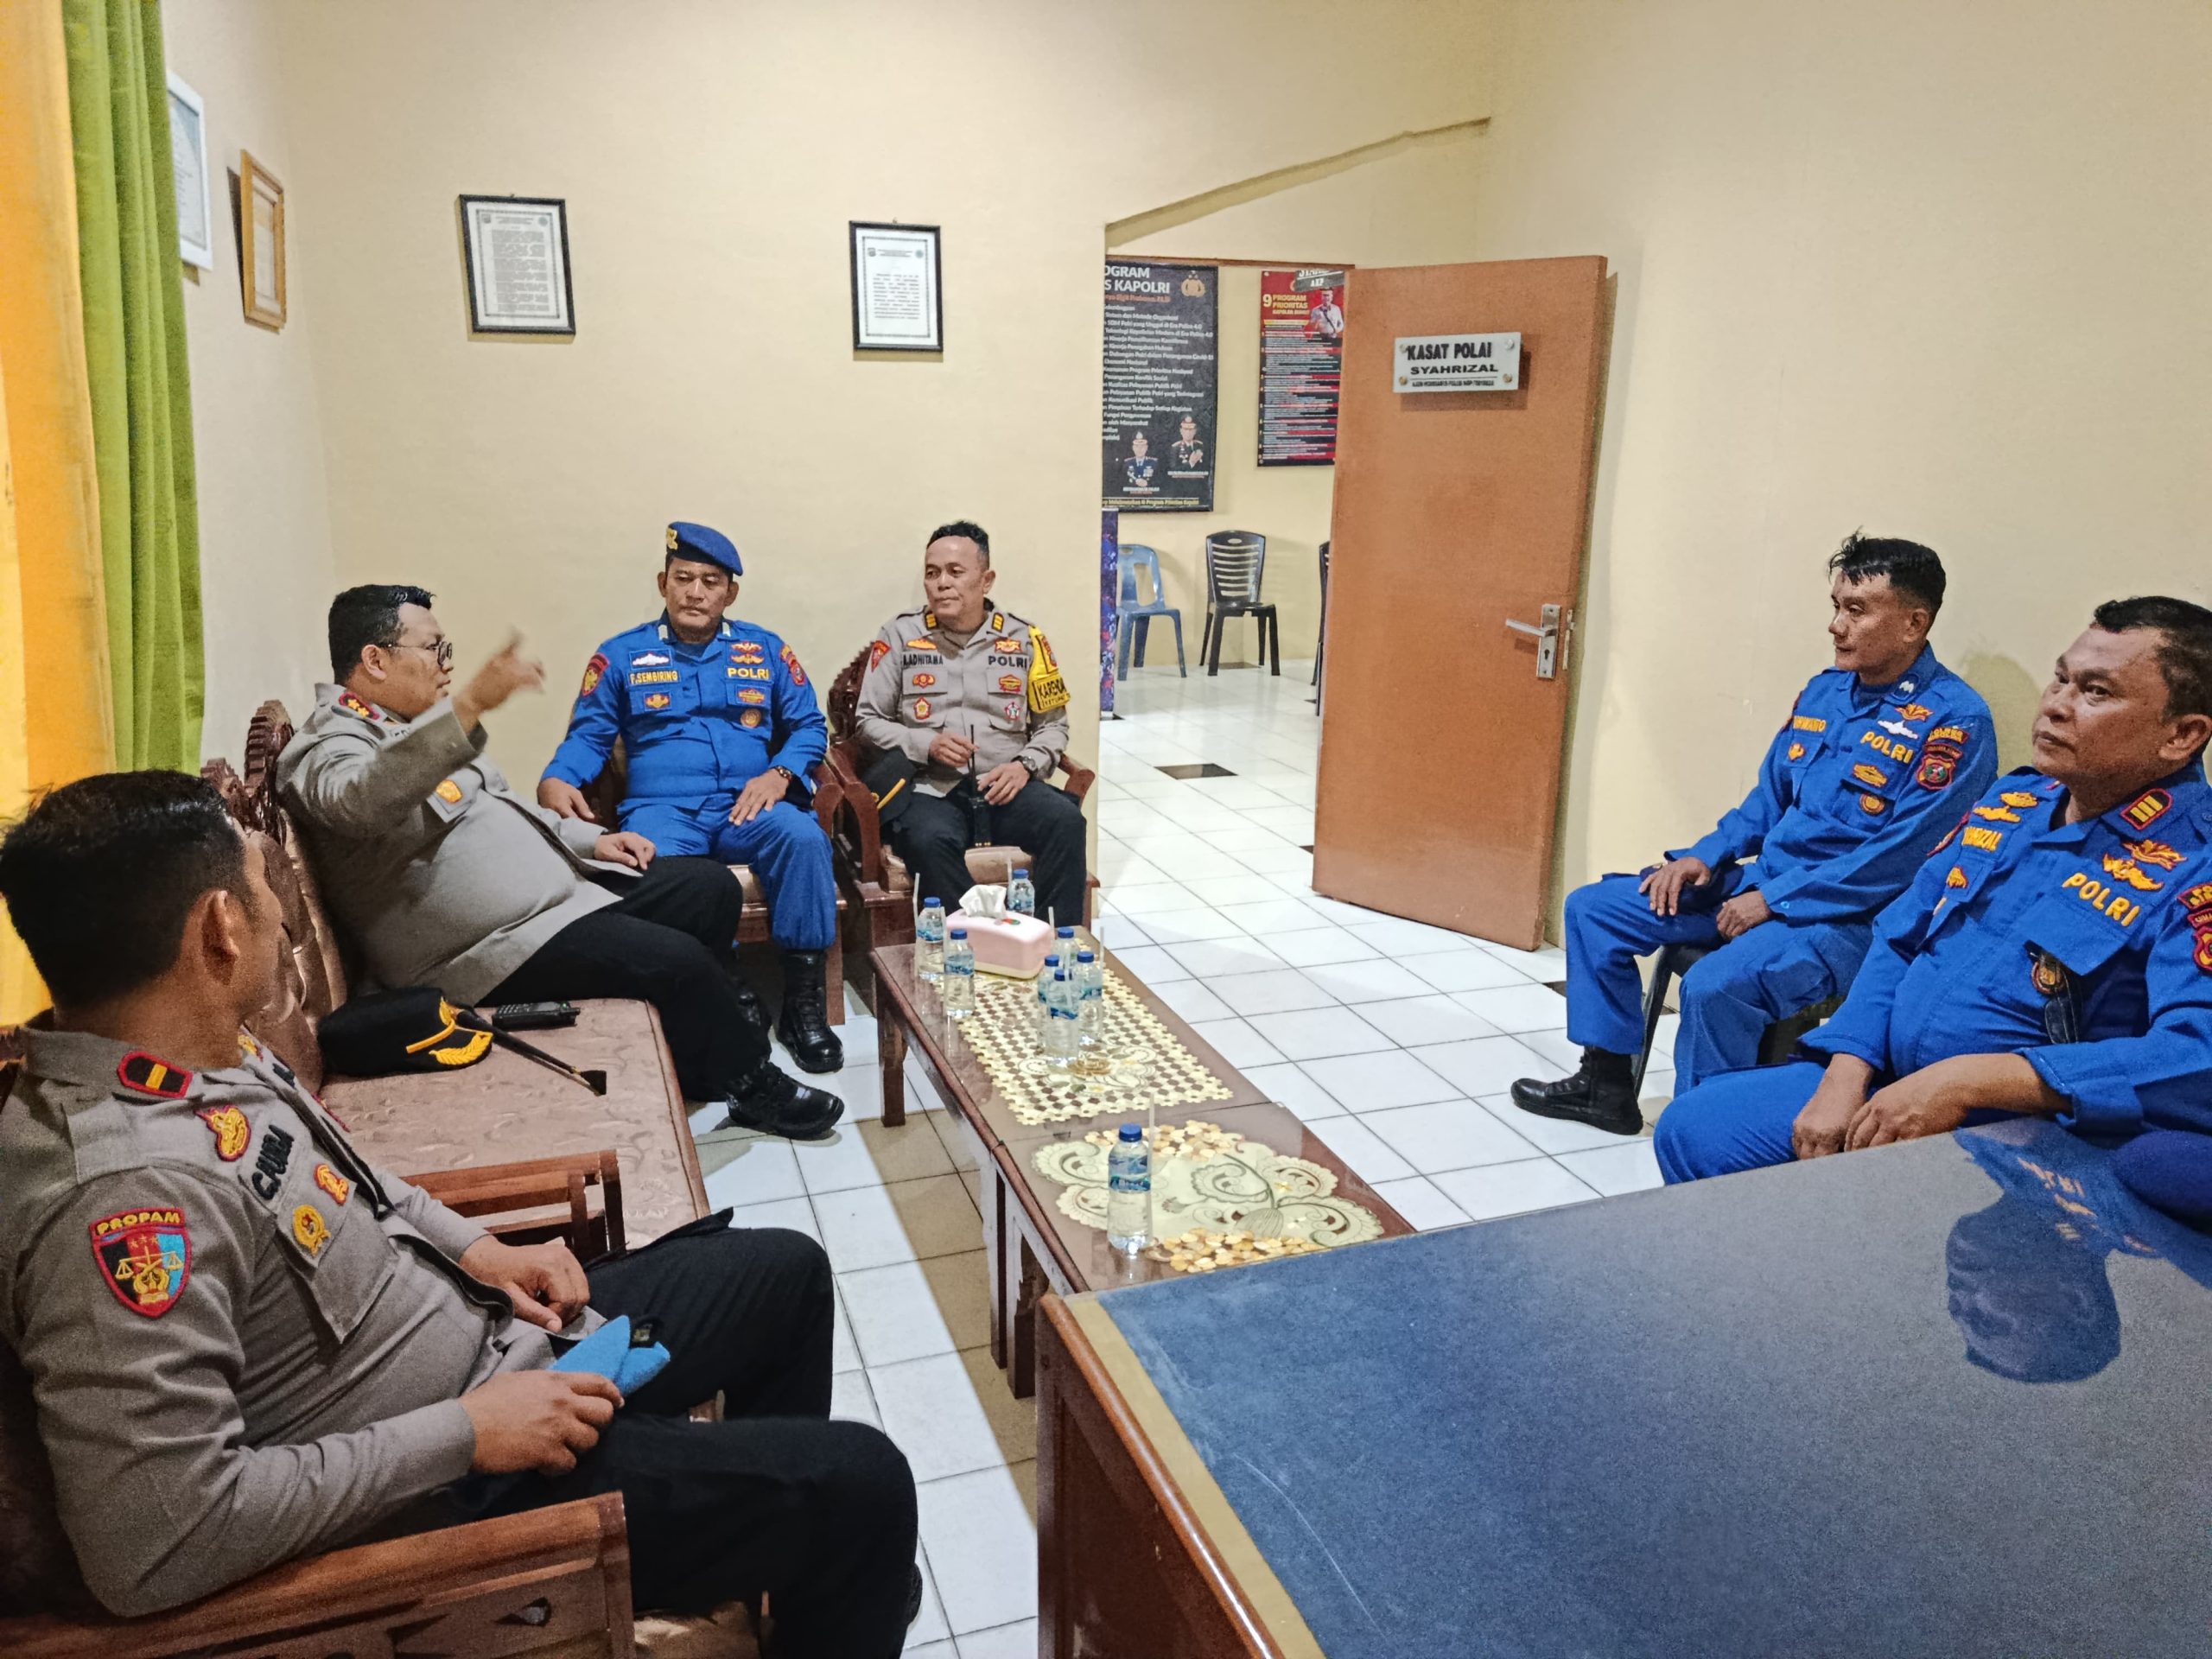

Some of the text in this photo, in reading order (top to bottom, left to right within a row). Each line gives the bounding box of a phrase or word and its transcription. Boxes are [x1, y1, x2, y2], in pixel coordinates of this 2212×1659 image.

[1115, 280, 1170, 294] KAPOLRI
[1262, 293, 1273, 308] 9
[1407, 344, 1449, 360] KASAT
[1410, 364, 1498, 375] SYAHRIZAL
[988, 655, 1027, 670] POLRI
[727, 667, 769, 680] POLRI
[1859, 731, 1915, 764] POLRI
[2062, 872, 2140, 927] POLRI
[97, 1211, 181, 1236] PROPAM
